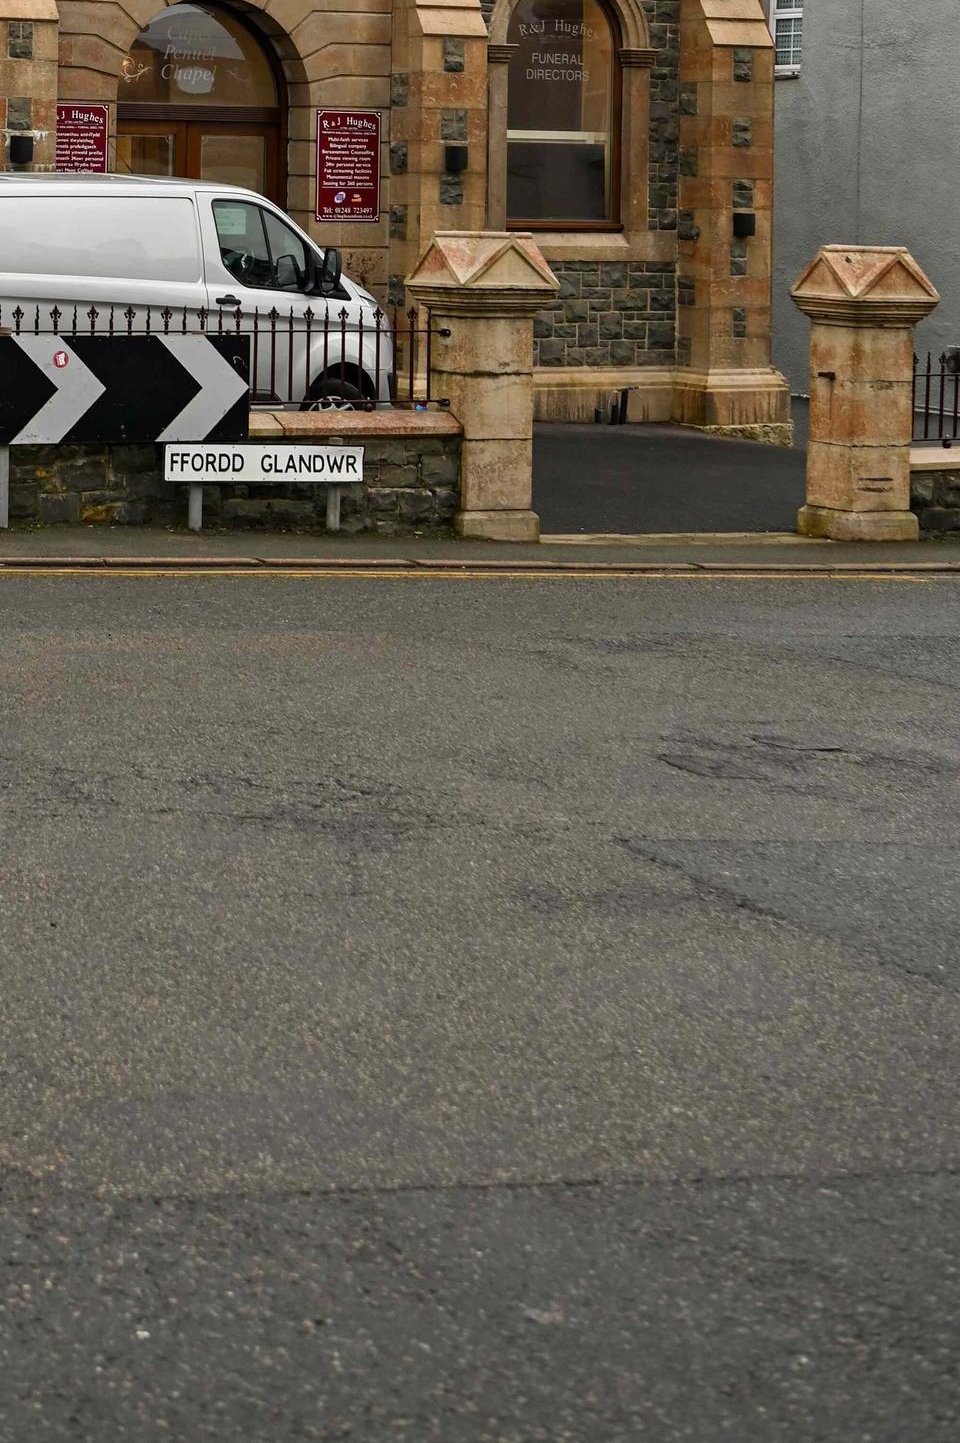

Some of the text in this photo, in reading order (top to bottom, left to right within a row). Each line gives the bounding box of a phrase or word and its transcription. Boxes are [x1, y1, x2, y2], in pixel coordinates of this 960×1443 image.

[554, 19, 600, 38] Hughes
[532, 53, 584, 65] FUNERAL
[161, 63, 216, 85] Chapel
[526, 69, 590, 81] DIRECTORS
[61, 111, 65, 119] J
[72, 110, 104, 124] Hughes
[323, 120, 330, 128] R
[337, 117, 340, 125] J
[347, 117, 376, 130] Hughes
[170, 452, 358, 474] FFORDD GLANDWR
